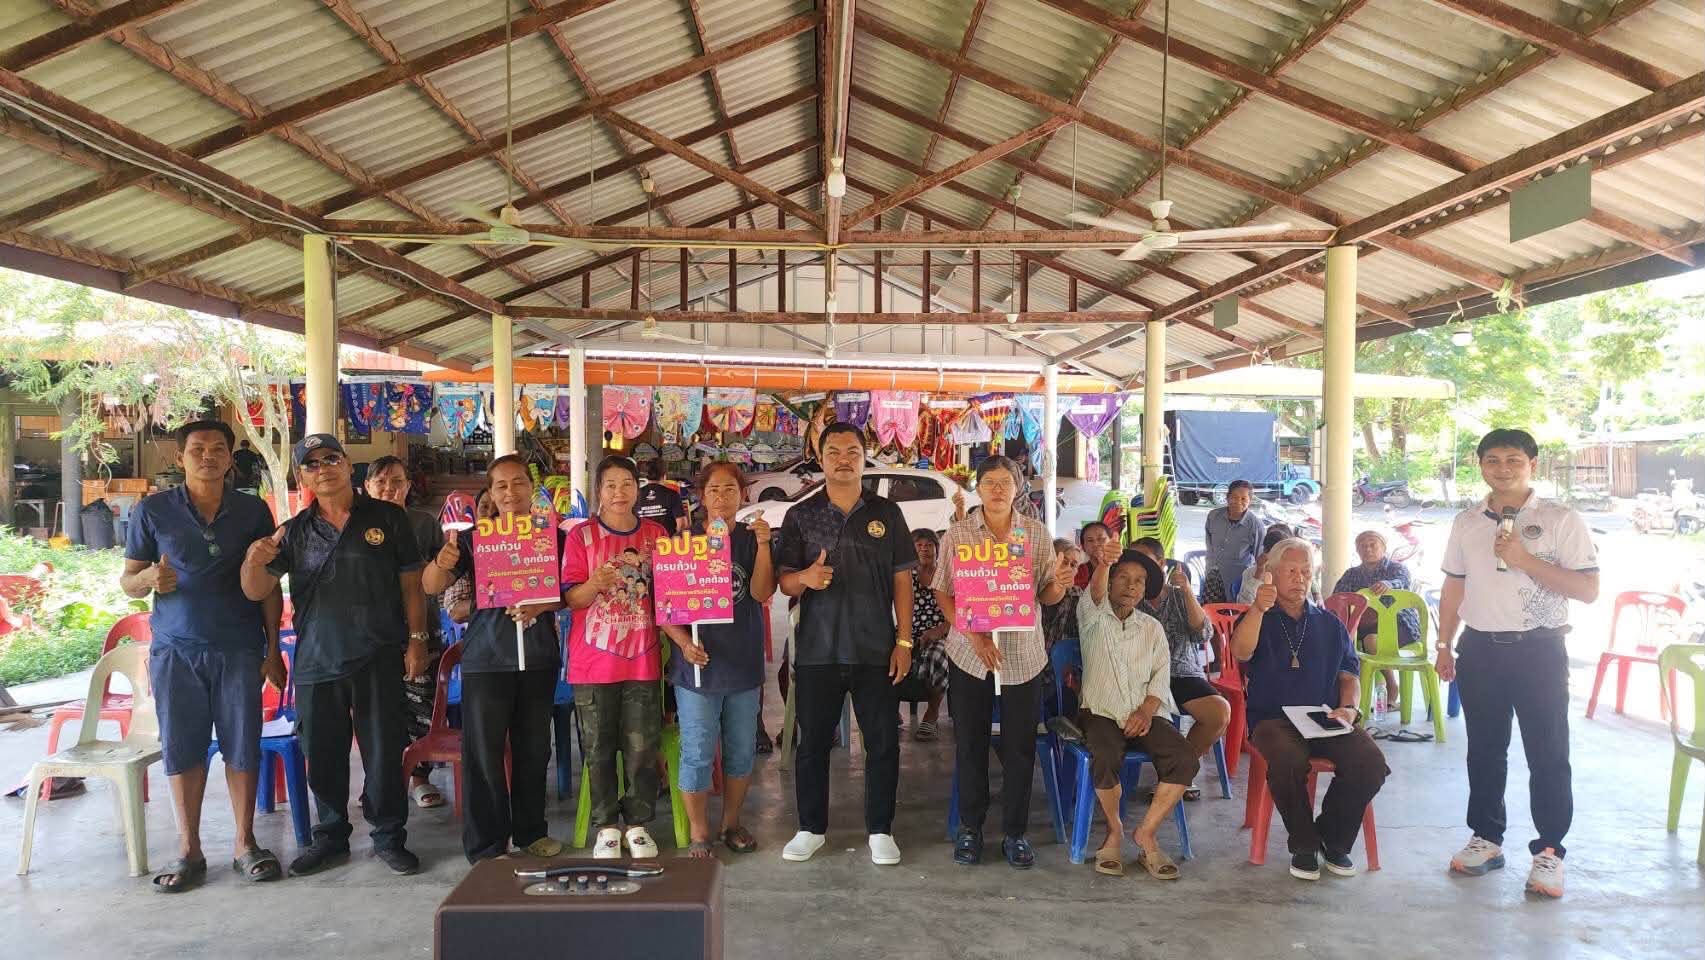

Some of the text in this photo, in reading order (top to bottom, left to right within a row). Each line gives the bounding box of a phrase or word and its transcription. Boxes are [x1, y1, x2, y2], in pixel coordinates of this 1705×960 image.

[477, 541, 521, 553] ครบถ้วน
[523, 553, 555, 566] ถูกต้อง
[656, 560, 697, 571] ครบถ้วน
[957, 566, 998, 577] ครบถ้วน
[699, 574, 729, 586] ถูกต้อง
[1000, 581, 1031, 593] ถูกต้อง
